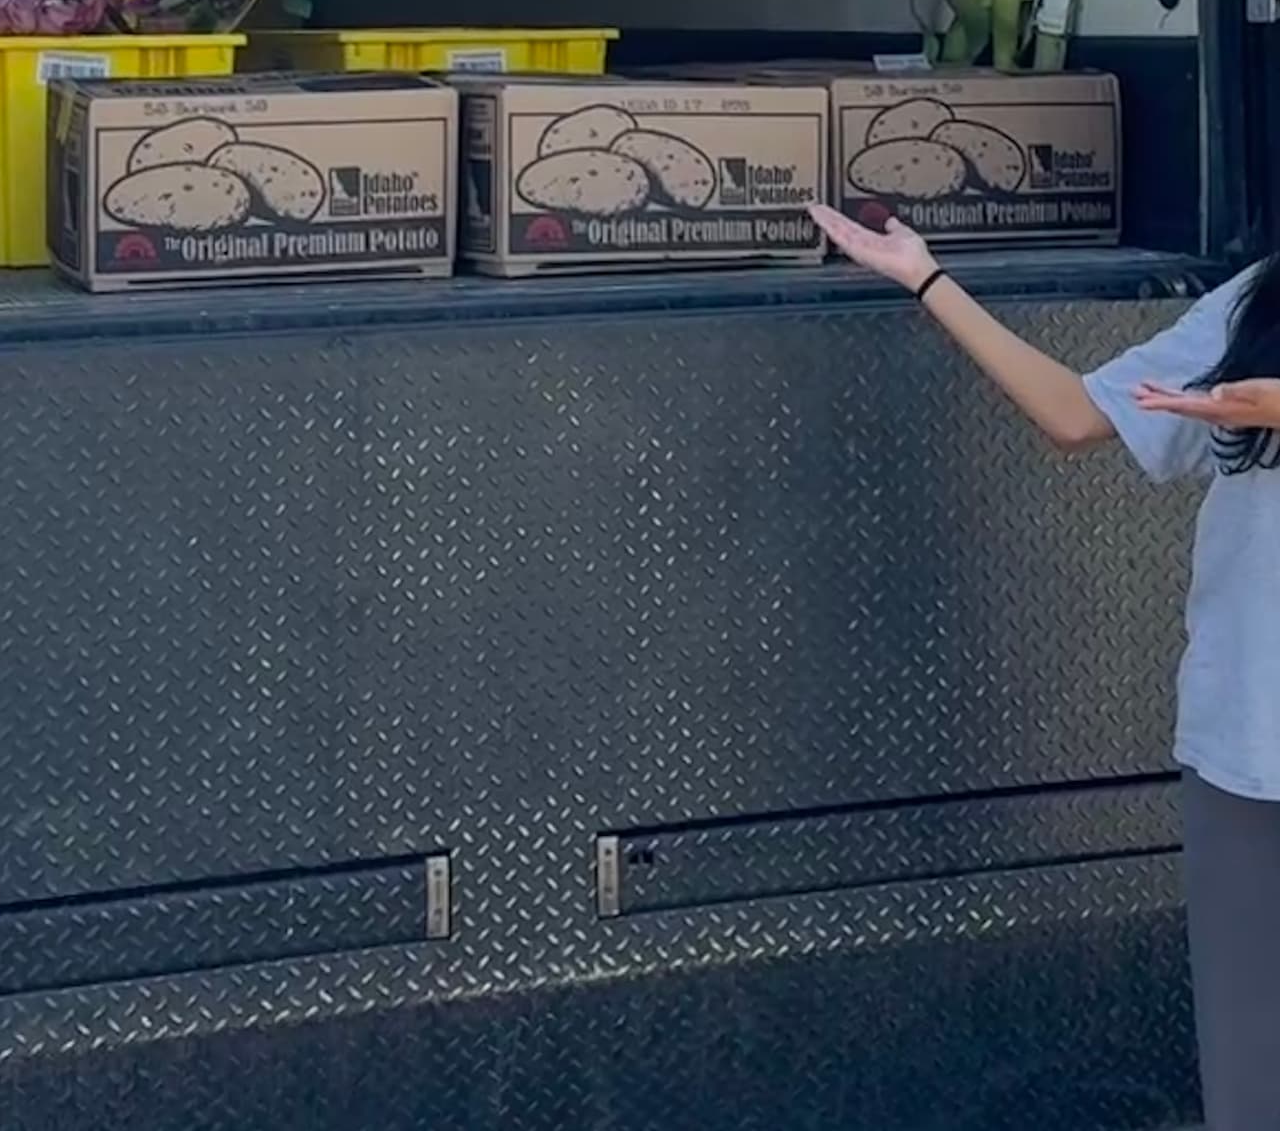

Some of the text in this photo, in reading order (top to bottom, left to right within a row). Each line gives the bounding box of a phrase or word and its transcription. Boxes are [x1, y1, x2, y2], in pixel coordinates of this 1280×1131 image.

[363, 172, 414, 193] Idaho
[362, 192, 438, 215] Potatoes
[912, 202, 984, 228] Original
[182, 230, 269, 263] Original
[275, 227, 365, 259] Premium
[371, 225, 439, 253] Potato
[588, 220, 669, 246] Original
[673, 219, 752, 243] Premium
[756, 217, 814, 241] Potato
